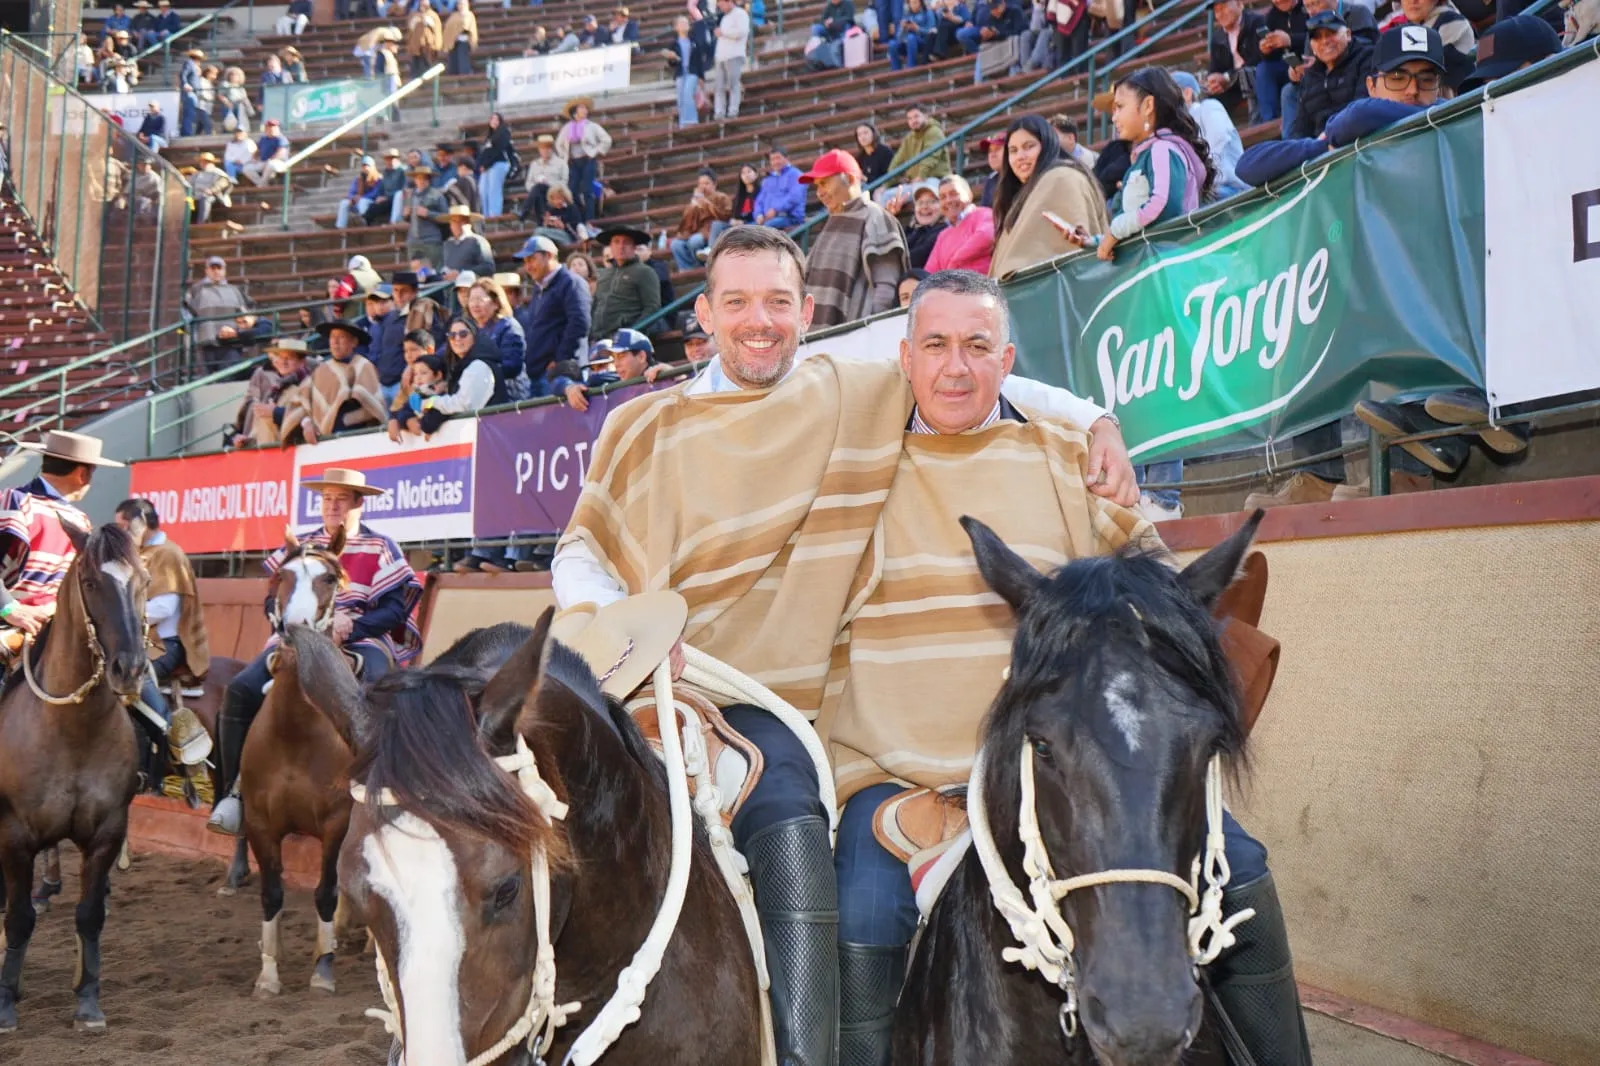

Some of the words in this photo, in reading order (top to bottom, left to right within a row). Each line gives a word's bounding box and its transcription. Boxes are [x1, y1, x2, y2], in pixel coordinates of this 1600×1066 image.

[512, 63, 614, 86] DEFENDER
[1087, 325, 1175, 414] San
[1177, 247, 1329, 401] Jorge
[515, 441, 599, 494] PICT
[130, 489, 179, 525] DIO
[180, 480, 288, 523] AGRICULTURA
[396, 474, 464, 510] Noticias
